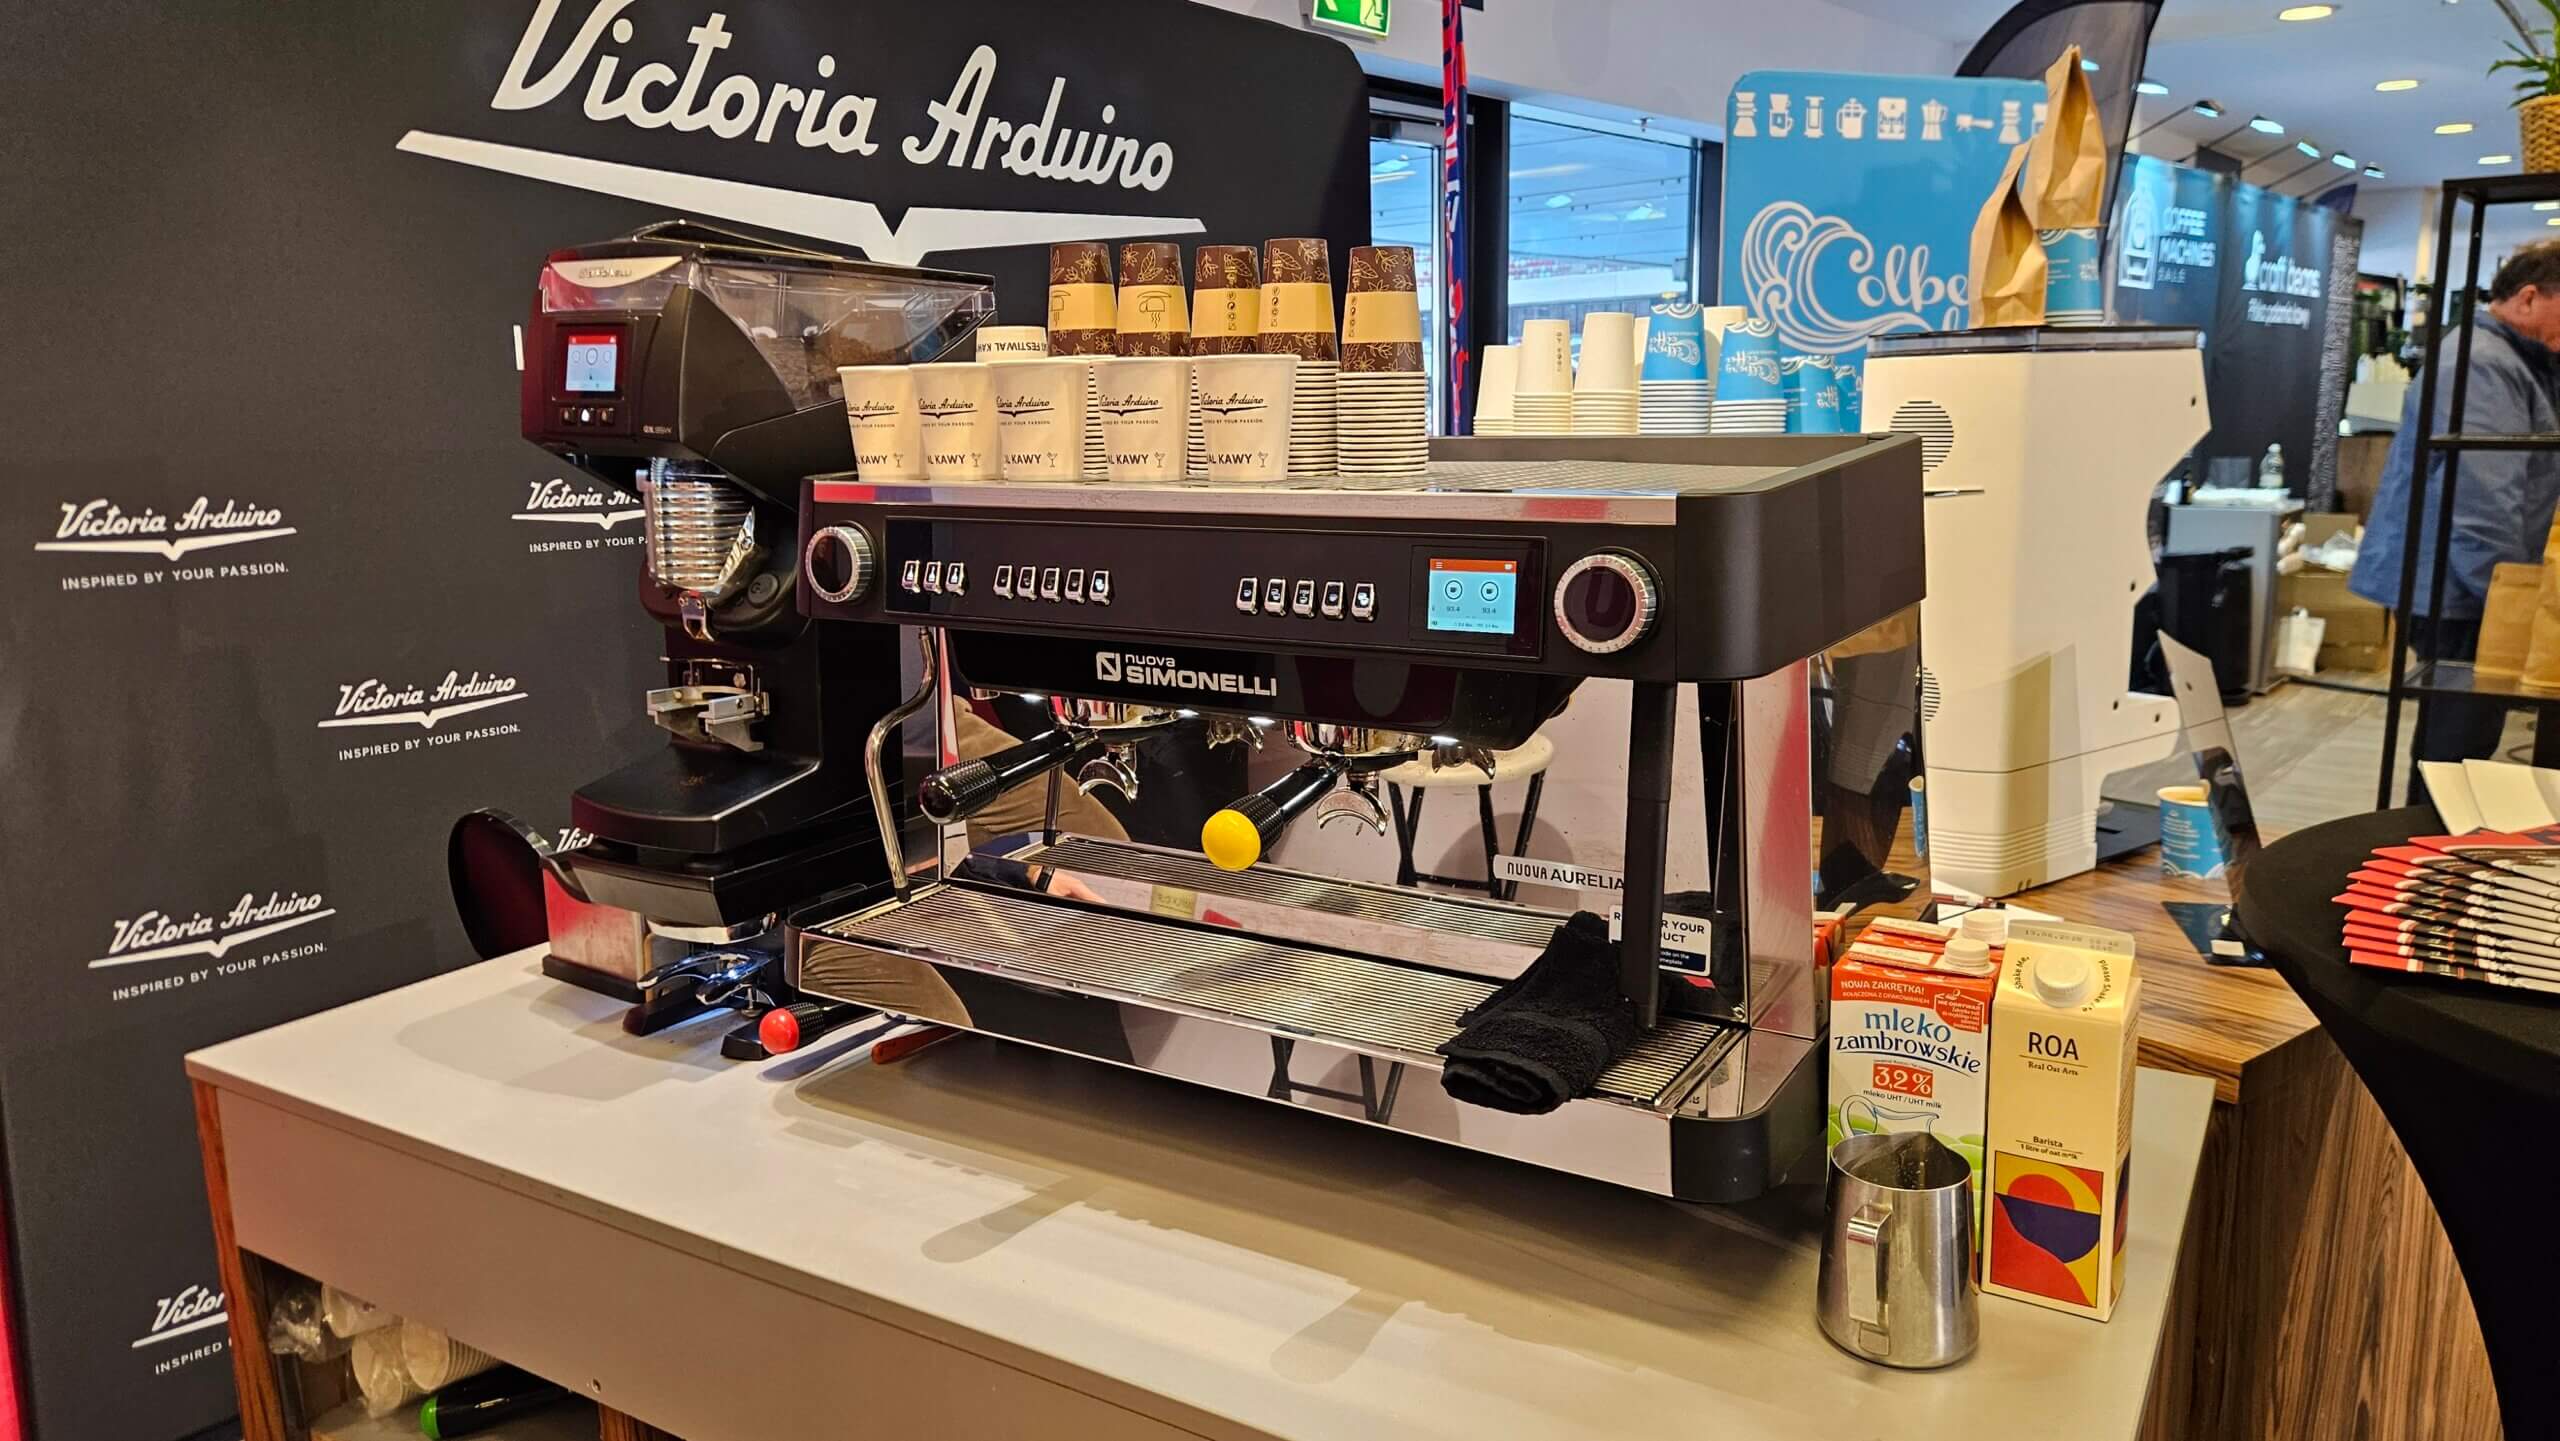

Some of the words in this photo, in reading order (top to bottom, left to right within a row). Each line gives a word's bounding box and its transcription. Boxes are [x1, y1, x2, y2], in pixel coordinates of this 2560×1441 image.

[490, 0, 880, 157] Victoria
[902, 45, 1174, 192] Arduino
[994, 342, 1041, 352] FESTIWAL
[862, 400, 895, 411] Arduino
[938, 398, 974, 409] Arduino
[1014, 396, 1050, 408] Arduino
[1122, 394, 1159, 406] Arduino
[1226, 393, 1263, 405] Arduino
[860, 455, 888, 464] KAWY
[936, 454, 966, 464] KAWY
[1011, 454, 1041, 464] KAWY
[1116, 454, 1149, 464] KAWY
[1219, 454, 1252, 464] KAWY
[526, 478, 603, 510] Victoria
[56, 498, 167, 539] Victoria
[174, 496, 282, 531] Arduino
[529, 540, 582, 553] INSPIRED
[585, 539, 599, 549] BY
[605, 536, 634, 547] YOUR
[62, 574, 138, 591] INSPIRED
[144, 571, 165, 585] BY
[172, 567, 215, 581] YOUR
[220, 561, 289, 578] PASSION.
[1125, 653, 1176, 667] nuova
[1126, 666, 1277, 697] SIMONELLI
[335, 678, 424, 716] Victoria
[430, 670, 517, 703] Arduino
[338, 742, 400, 761] INSPIRED
[404, 738, 421, 751] BY
[426, 732, 461, 747] YOUR
[465, 723, 521, 741] PASSION.
[1507, 862, 1547, 880] NUOVA
[1550, 868, 1625, 890] AURELIA
[108, 910, 213, 955] Victoria
[220, 891, 322, 929] Arduino
[1672, 920, 1705, 934] YOUR
[112, 975, 184, 1001] INSPIRED
[190, 969, 209, 983] BY
[216, 958, 257, 977] YOUR
[262, 942, 328, 966] PASSION.
[1841, 981, 1870, 989] NOWA
[1865, 1008, 1951, 1042] mleko
[1834, 1031, 1981, 1073] zambrowskie
[2029, 1031, 2079, 1061] ROA
[2028, 1061, 2044, 1070] Real
[2047, 1064, 2060, 1073] Oat
[2062, 1067, 2078, 1076] Arts
[1864, 1089, 1885, 1099] mleko
[1887, 1094, 1903, 1103] UHT
[1909, 1097, 1924, 1106] UHT
[1926, 1101, 1942, 1109] milk
[2033, 1136, 2063, 1148] Barista
[151, 1284, 225, 1332] Victor
[155, 1341, 222, 1375] INSPIRED
